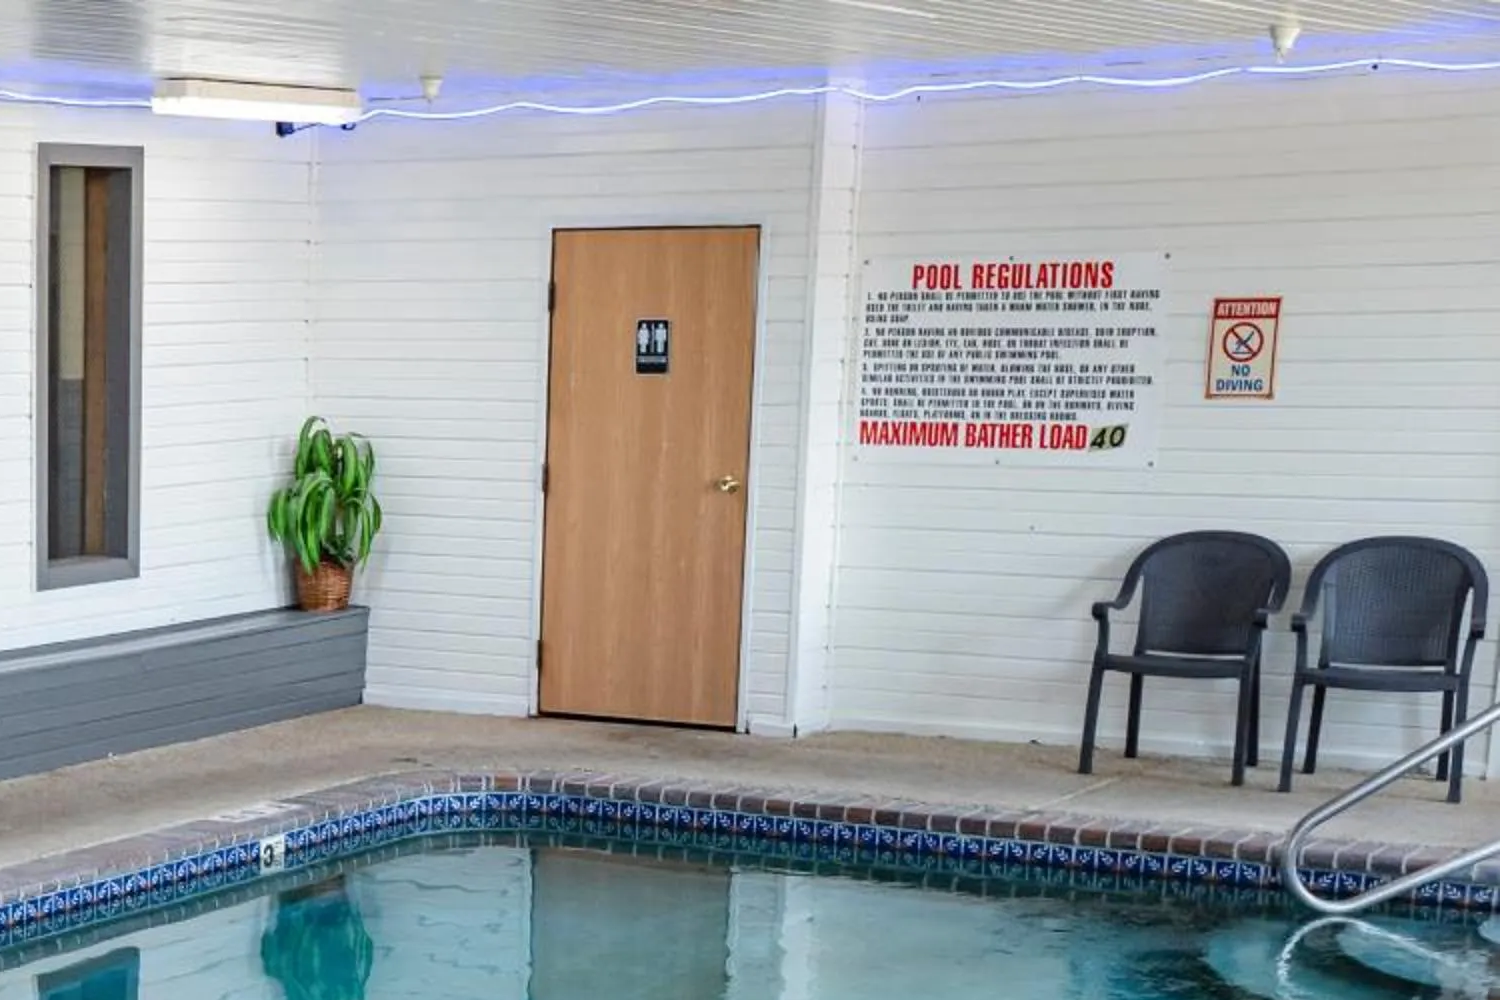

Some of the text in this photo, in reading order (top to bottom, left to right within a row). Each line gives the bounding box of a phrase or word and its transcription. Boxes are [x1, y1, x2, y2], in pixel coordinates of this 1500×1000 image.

[912, 262, 1113, 290] POOL REGULATIONS
[1231, 364, 1251, 377] NO
[1215, 379, 1263, 391] DIVING
[859, 422, 1126, 450] MAXIMUM BATHER LOAD 40
